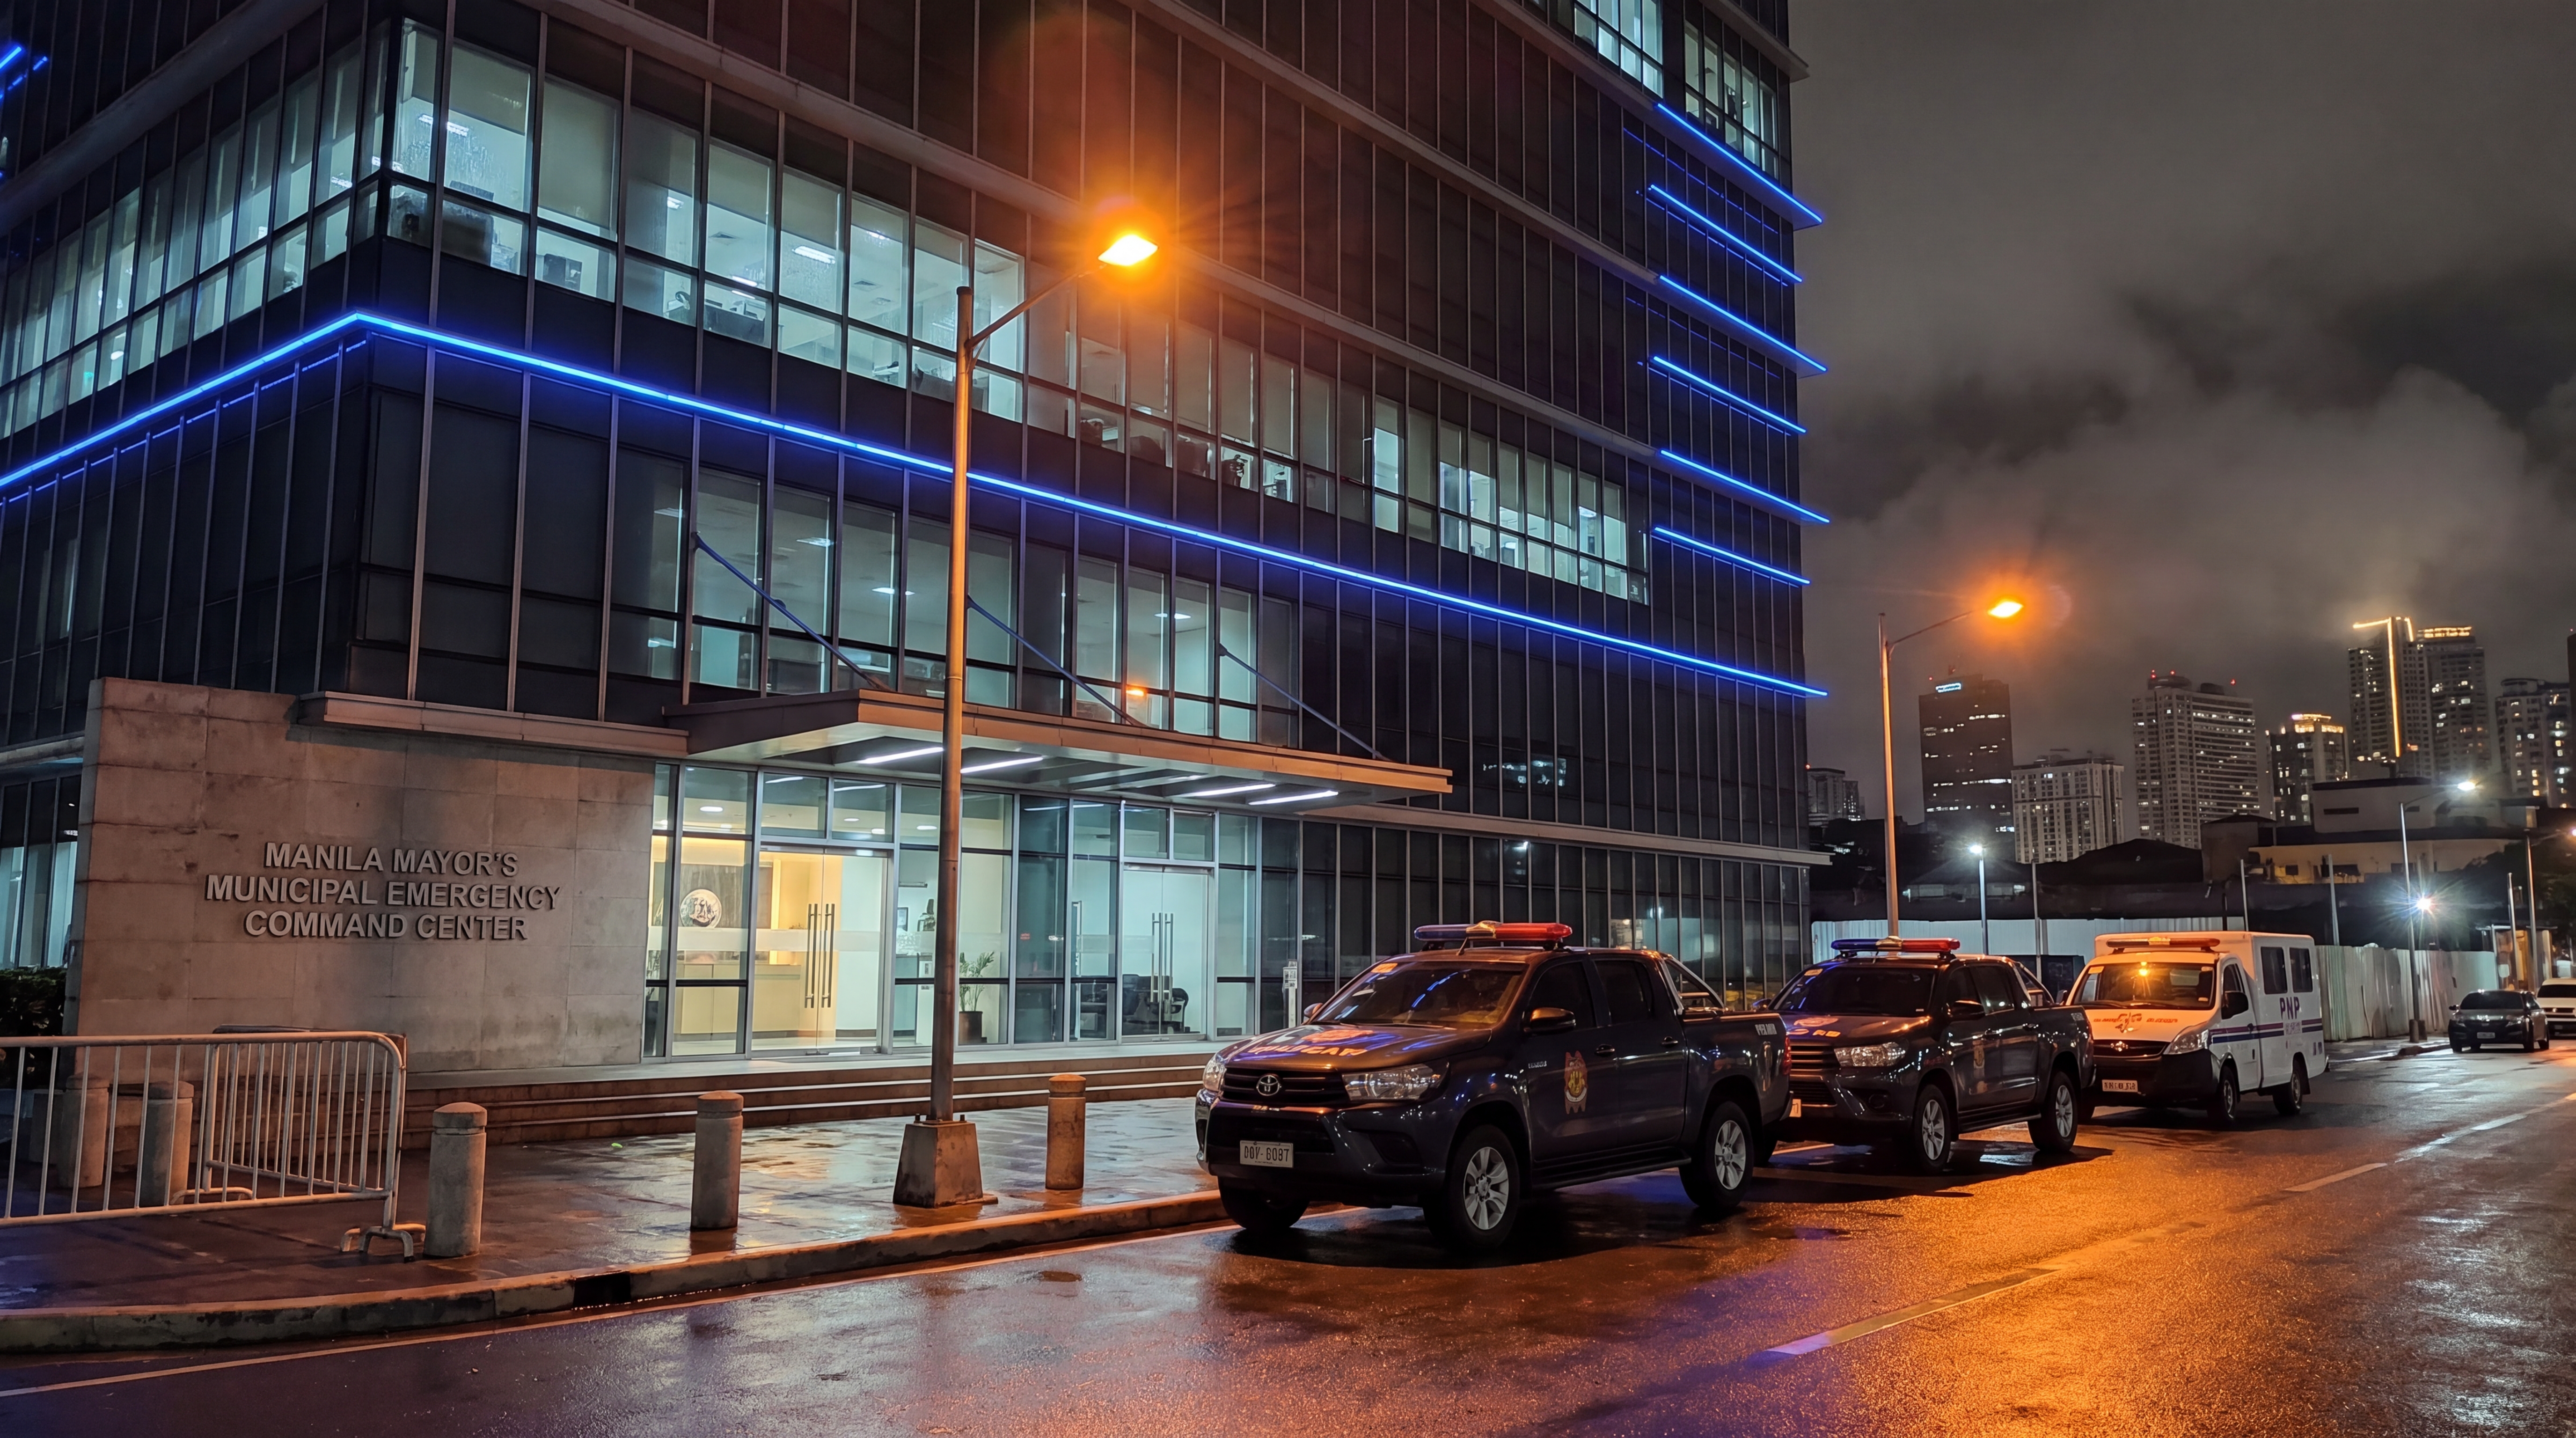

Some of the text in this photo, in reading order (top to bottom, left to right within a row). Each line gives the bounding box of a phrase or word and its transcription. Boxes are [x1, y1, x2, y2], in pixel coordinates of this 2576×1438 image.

[264, 842, 519, 877] MANILA MAYOR'S
[206, 874, 560, 910] MUNICIPAL EMERGENCY
[244, 910, 527, 940] COMMAND CENTER
[2279, 997, 2300, 1020] PNP
